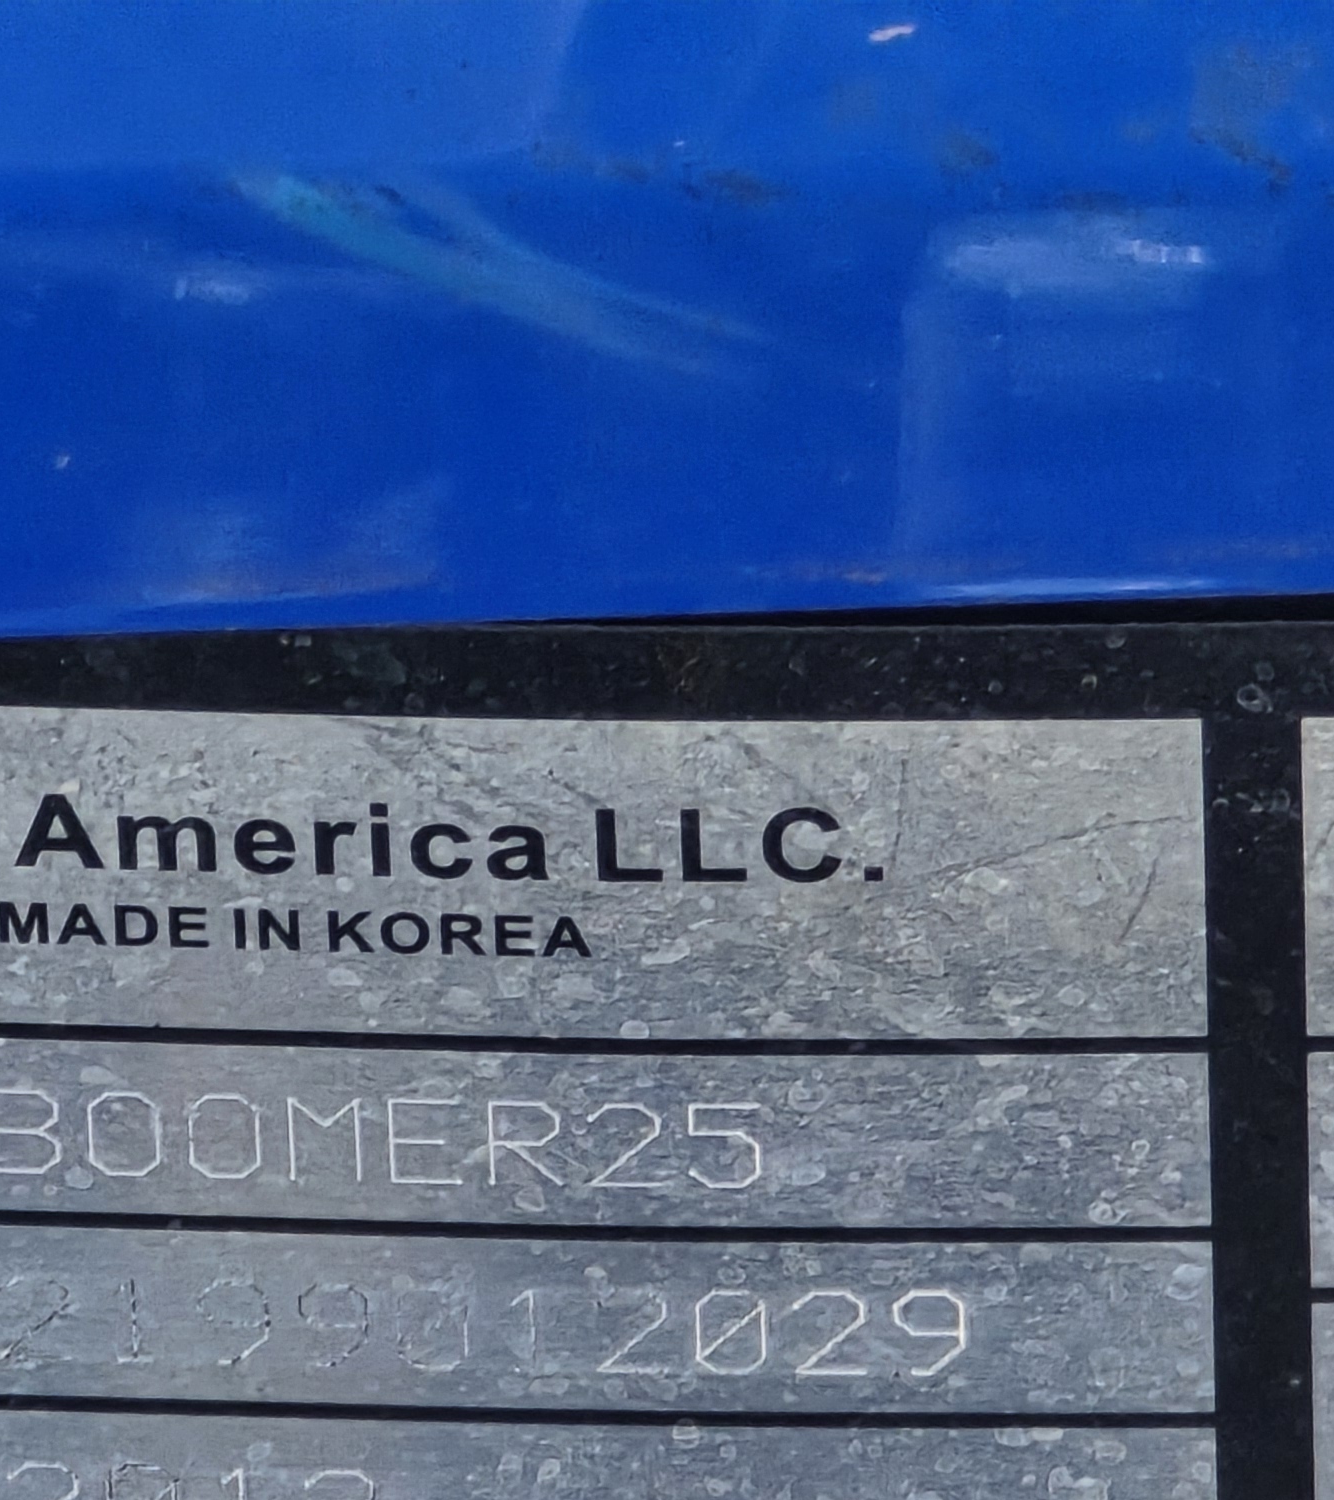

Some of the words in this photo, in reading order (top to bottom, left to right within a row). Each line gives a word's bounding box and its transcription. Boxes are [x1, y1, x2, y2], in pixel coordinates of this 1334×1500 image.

[14, 792, 549, 882] America
[594, 806, 885, 884] LLC.
[233, 905, 301, 952] IN
[327, 909, 593, 958] KOREA
